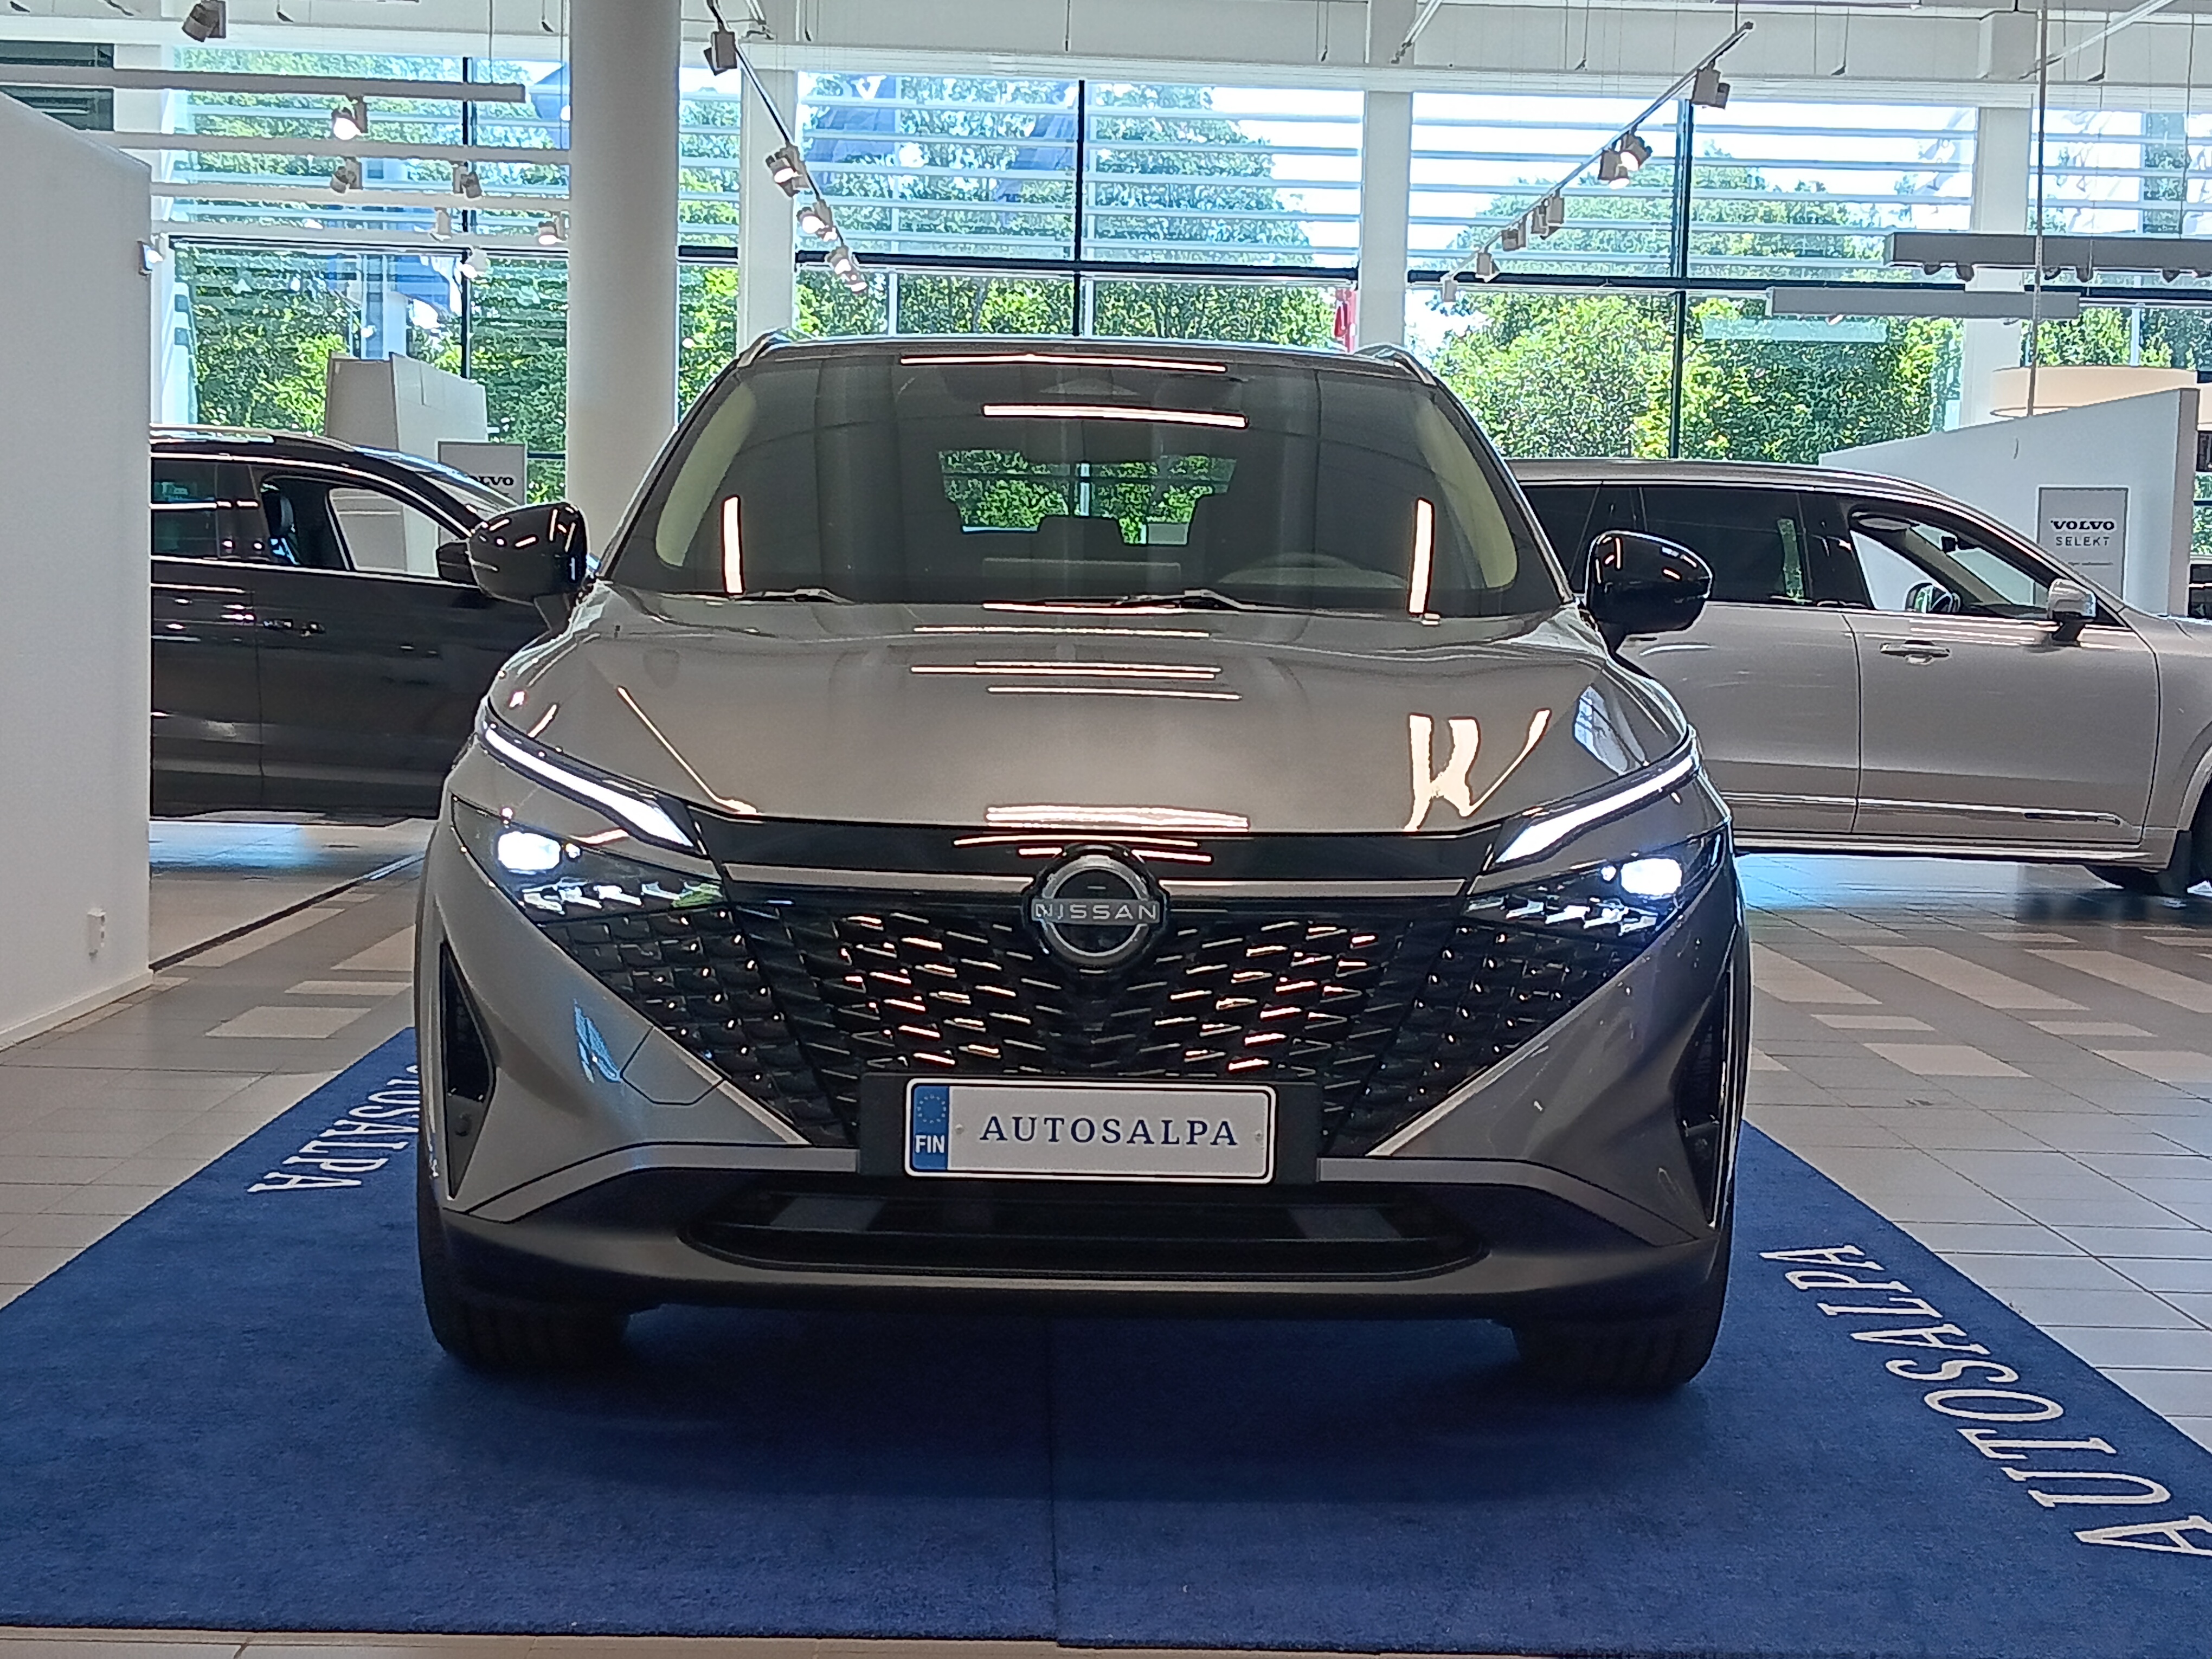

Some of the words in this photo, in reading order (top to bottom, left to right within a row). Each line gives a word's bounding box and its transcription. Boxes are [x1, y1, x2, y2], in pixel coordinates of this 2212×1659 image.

[2050, 520, 2115, 531] VOLVO
[2056, 536, 2110, 546] SELEKT
[1035, 903, 1156, 920] NISSAN
[979, 1115, 1238, 1146] AUTOSALPA
[915, 1135, 946, 1154] FIN
[1759, 1244, 2212, 1557] AUTOSALPA
